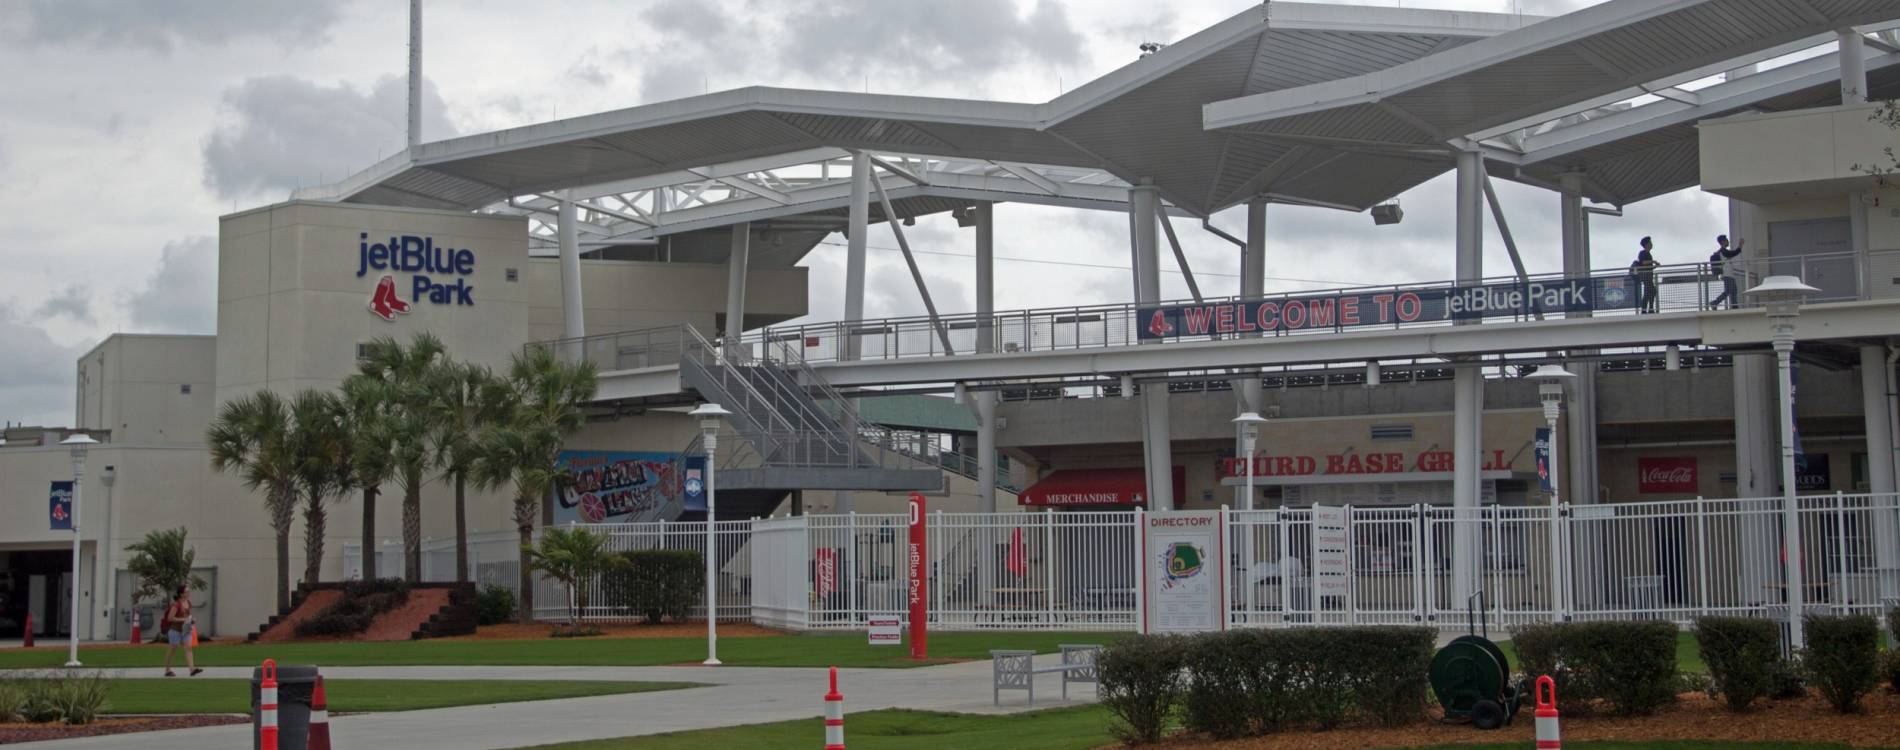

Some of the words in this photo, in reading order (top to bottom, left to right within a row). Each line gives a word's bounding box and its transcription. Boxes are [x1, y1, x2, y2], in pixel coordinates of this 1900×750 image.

[356, 232, 475, 277] jetBlue
[411, 275, 474, 306] Park
[1443, 286, 1521, 319] jetBlue
[1528, 280, 1587, 308] Park
[1184, 295, 1360, 335] WELCOME
[1372, 292, 1422, 322] TO
[1222, 455, 1315, 476] THIRD
[1326, 452, 1404, 474] BASE
[1416, 449, 1512, 472] GRL
[1046, 492, 1119, 505] MERCHANDISE
[1151, 516, 1213, 528] DIRECTORY
[910, 543, 920, 578] jetBlue
[910, 579, 920, 604] Park
